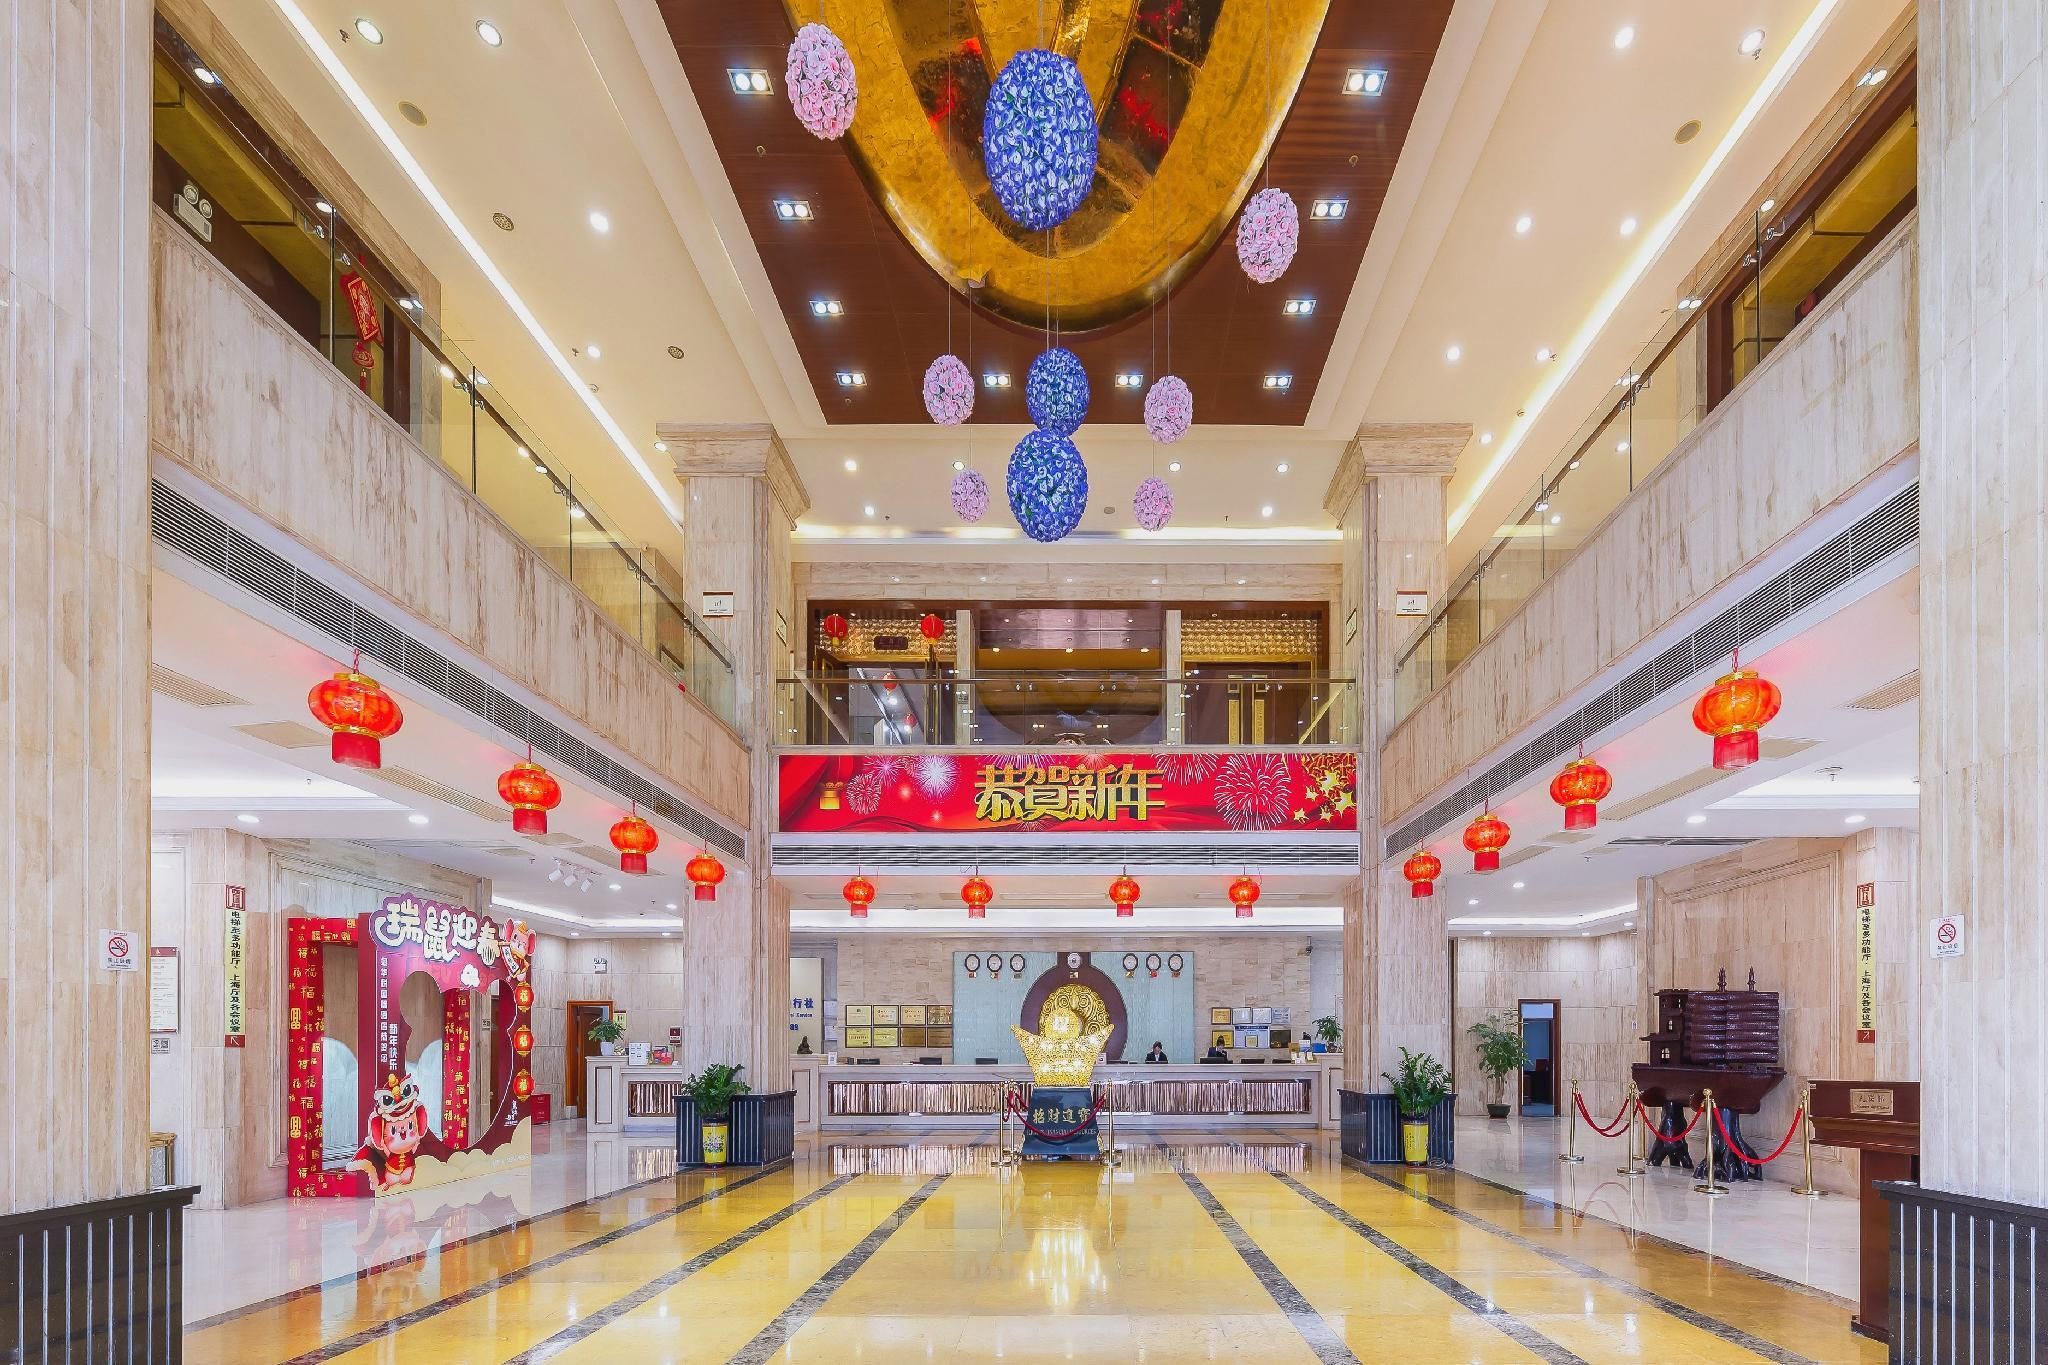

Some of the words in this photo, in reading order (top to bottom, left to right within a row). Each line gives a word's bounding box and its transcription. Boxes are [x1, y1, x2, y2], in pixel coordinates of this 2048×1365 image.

[375, 898, 501, 966] 瑞鼠迎春
[389, 1022, 398, 1071] 新年快乐
